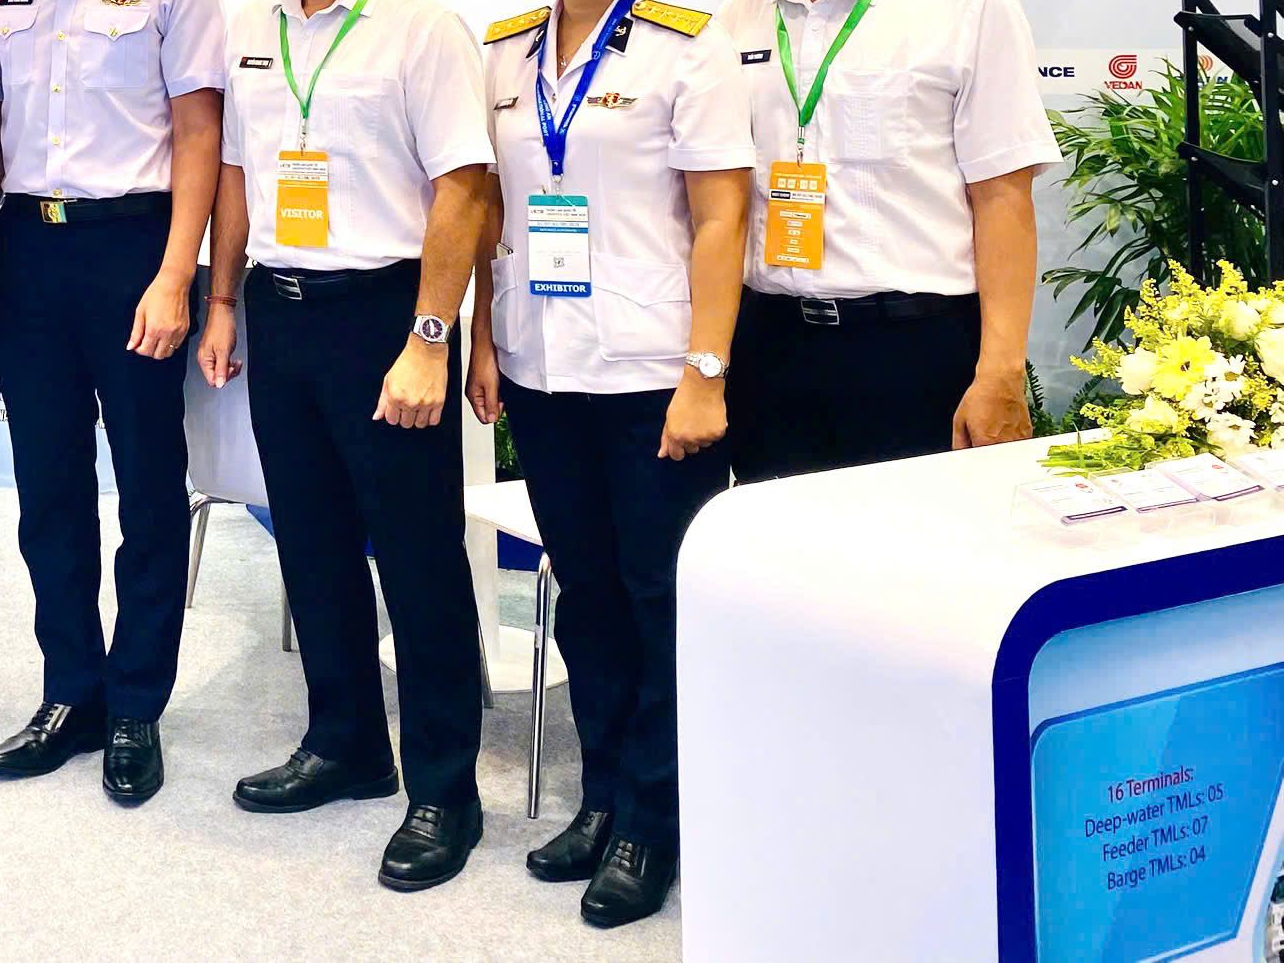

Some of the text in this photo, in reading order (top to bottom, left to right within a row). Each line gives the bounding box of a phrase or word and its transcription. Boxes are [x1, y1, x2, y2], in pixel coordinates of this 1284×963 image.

[1105, 81, 1143, 90] VEDAN
[280, 208, 324, 220] VISITOR
[534, 283, 587, 293] EXHIBITOR
[1108, 765, 1194, 803] 16 Terminals:
[1085, 783, 1223, 837] Deep-water TMLs: 05
[1103, 815, 1208, 861] Feeder TMLs: 07
[1107, 845, 1205, 890] Barge TMLs: 04
